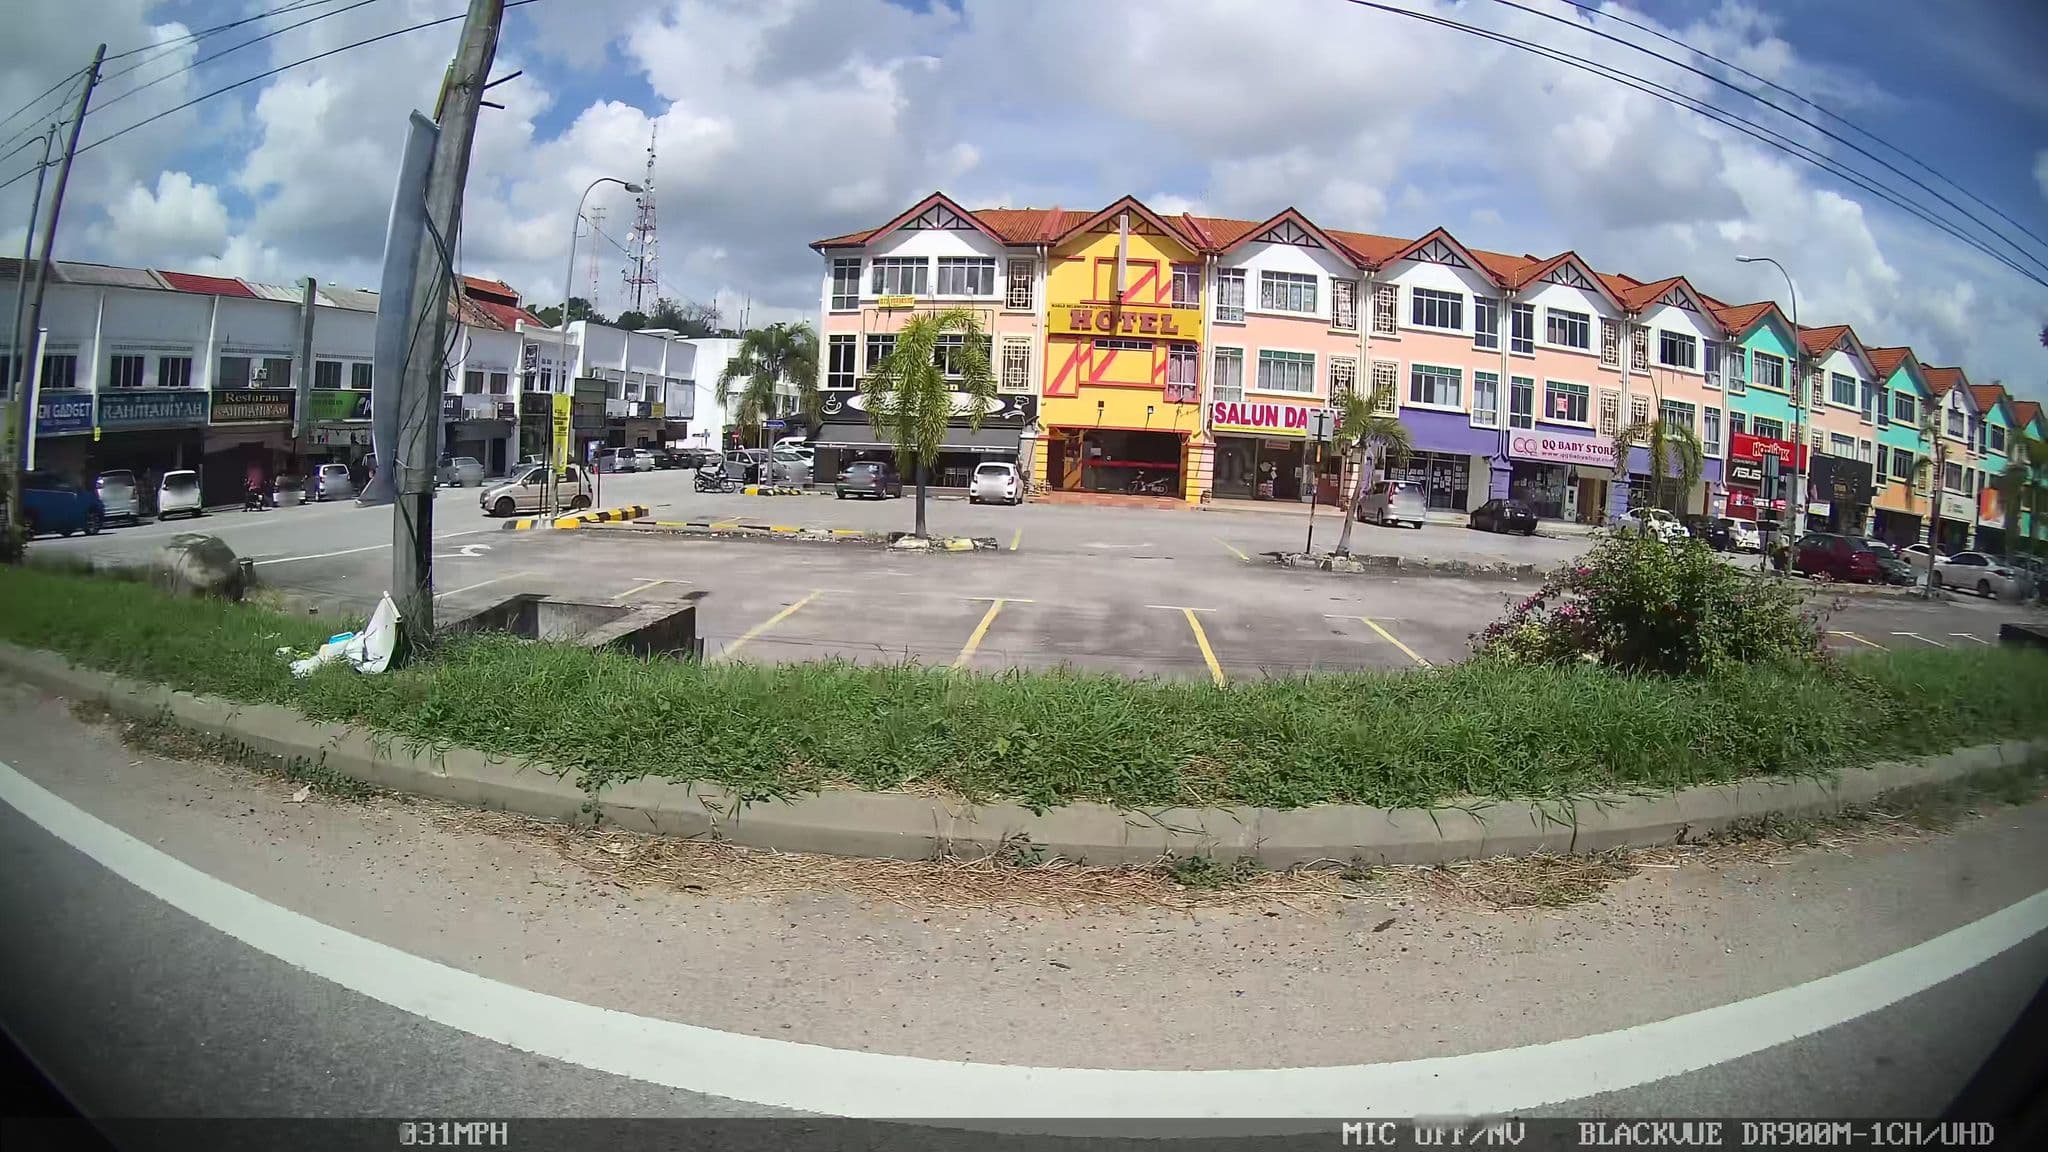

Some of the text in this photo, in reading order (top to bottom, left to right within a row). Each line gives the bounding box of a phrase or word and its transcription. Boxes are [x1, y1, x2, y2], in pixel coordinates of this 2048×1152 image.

[1070, 309, 1179, 335] HOTEL
[225, 392, 279, 402] Restoran
[53, 402, 91, 418] GADGET
[1215, 401, 1279, 427] SALUN
[1542, 439, 1556, 452] QQ
[1558, 441, 1585, 454] BABY
[1732, 466, 1762, 481] ASUS
